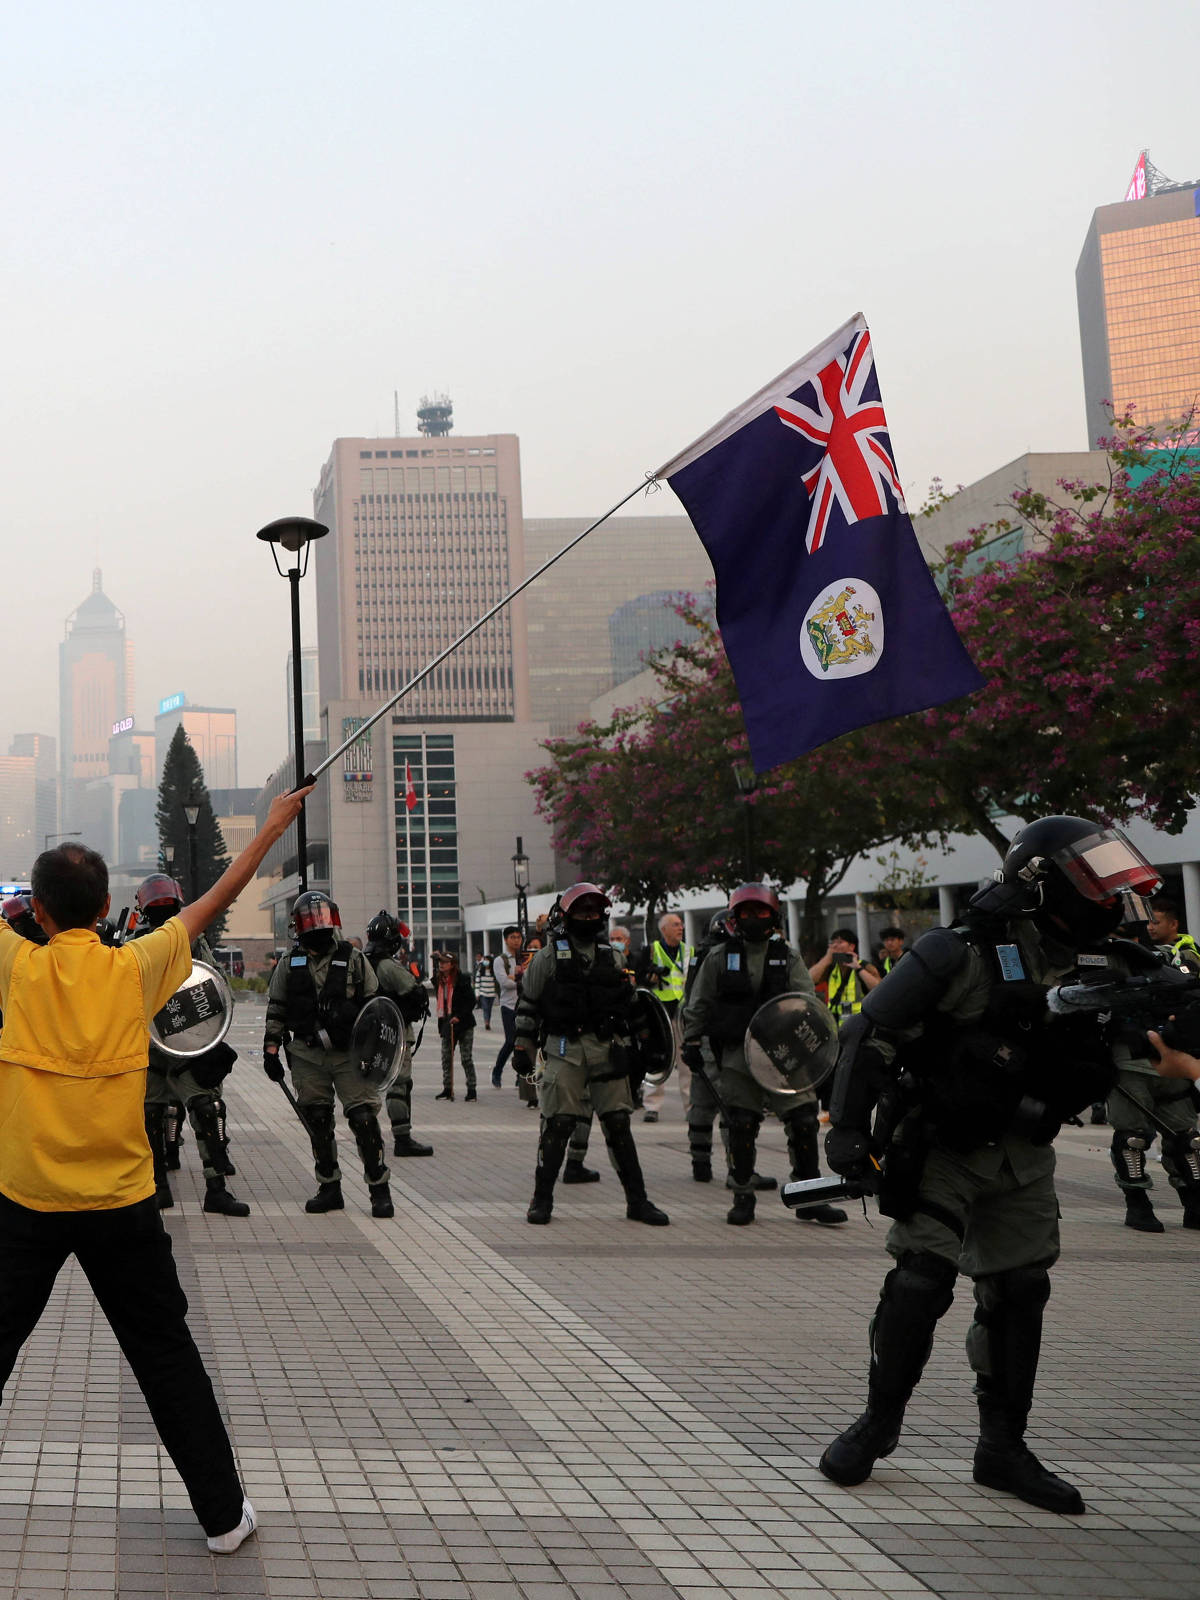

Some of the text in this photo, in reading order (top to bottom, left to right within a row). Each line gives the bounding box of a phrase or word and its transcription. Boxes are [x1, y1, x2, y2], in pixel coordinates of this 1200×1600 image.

[112, 717, 133, 735] LG OLED
[1079, 955, 1106, 965] POLICE
[190, 986, 213, 1019] POLICE
[795, 1020, 822, 1053] POLICE
